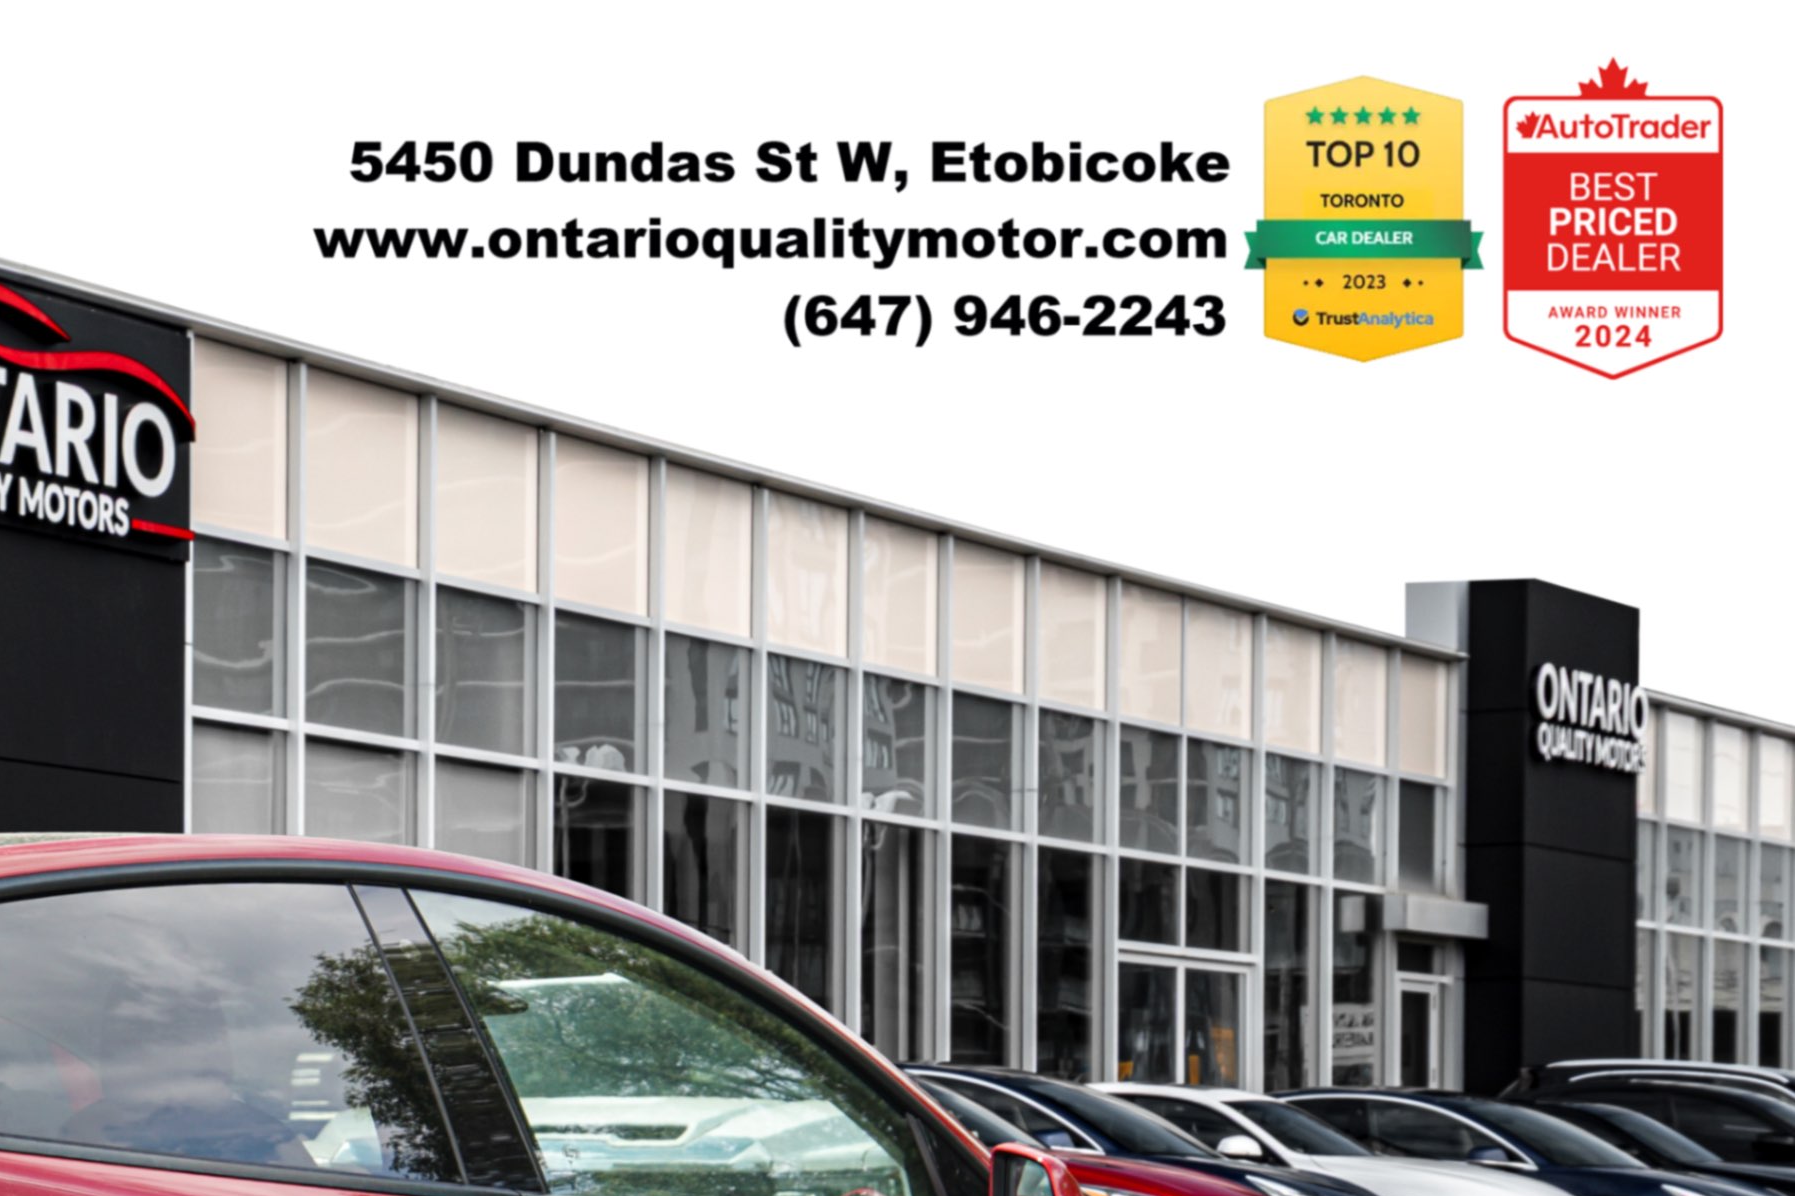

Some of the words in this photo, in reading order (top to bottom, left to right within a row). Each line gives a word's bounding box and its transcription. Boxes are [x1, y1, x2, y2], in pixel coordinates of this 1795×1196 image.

[19, 476, 130, 537] MOTORS
[1537, 662, 1649, 739] ONTARIO
[1537, 722, 1594, 763] QUALITY
